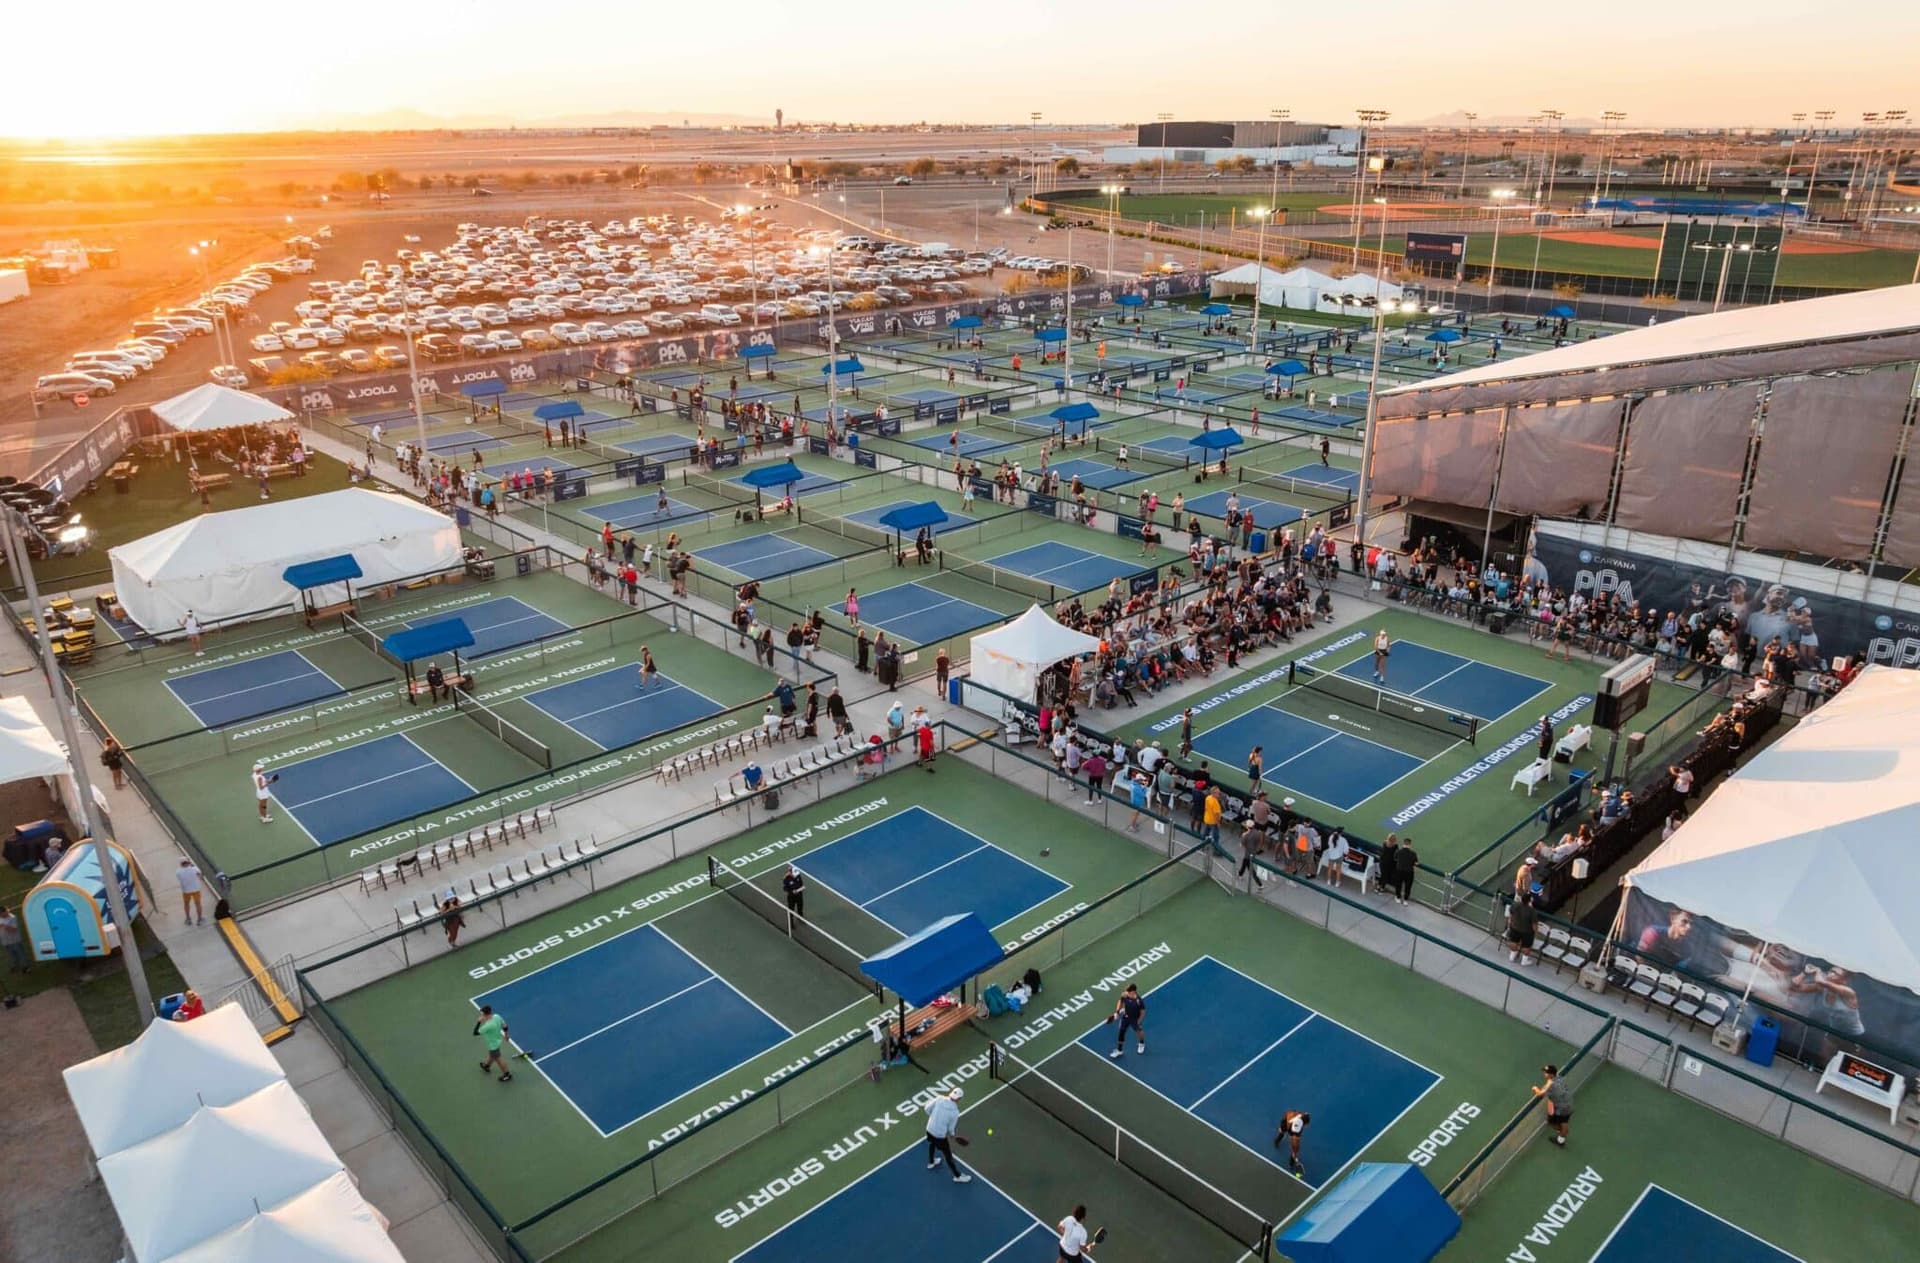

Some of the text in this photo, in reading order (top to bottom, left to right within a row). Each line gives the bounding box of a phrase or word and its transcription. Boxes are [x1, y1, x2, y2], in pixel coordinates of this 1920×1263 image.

[749, 331, 774, 346] PPA
[658, 343, 688, 360] PPA
[462, 370, 498, 383] JOOLA
[510, 363, 536, 379] PPA
[302, 391, 333, 408] PPA
[358, 384, 398, 397] JOOLA
[1594, 555, 1636, 571] CARVANA
[1574, 568, 1634, 608] PPA
[433, 591, 492, 611] ARIZONA
[364, 606, 430, 626] ATHLETIC
[167, 654, 234, 674] SPORTS
[552, 657, 616, 679] ARIZONA
[232, 713, 312, 740] ARIZONA
[316, 691, 395, 717] ATHLETIC
[525, 639, 584, 660] SPORTS
[478, 677, 549, 701] ATHLETIC
[1230, 669, 1285, 695] GROUNDS
[1200, 696, 1227, 710] UTR
[1221, 691, 1235, 700] X
[1152, 706, 1202, 731] SORTS
[336, 726, 373, 743] UTR
[256, 738, 333, 764] SPORTS
[1391, 792, 1443, 826] ARIZONA
[1439, 760, 1490, 794] ATHLETIC
[1487, 733, 1534, 765] GROUNDS
[1554, 695, 1593, 720] SPORTS
[349, 719, 738, 858] ARIZONA ATHLETIC GROUNDS X UTR SPORTS
[468, 797, 888, 980] ARIZONA ATHLETIC GROUNDS X UTR SPORTS
[1092, 941, 1172, 992] ARIZONA
[1003, 990, 1094, 1049] ATHLETIC
[873, 1112, 899, 1131] X
[823, 1125, 878, 1161] UTR
[1407, 1102, 1482, 1167] SPORTS
[714, 1157, 825, 1228] SPORTS
[1525, 1165, 1604, 1245] ARIZONA
